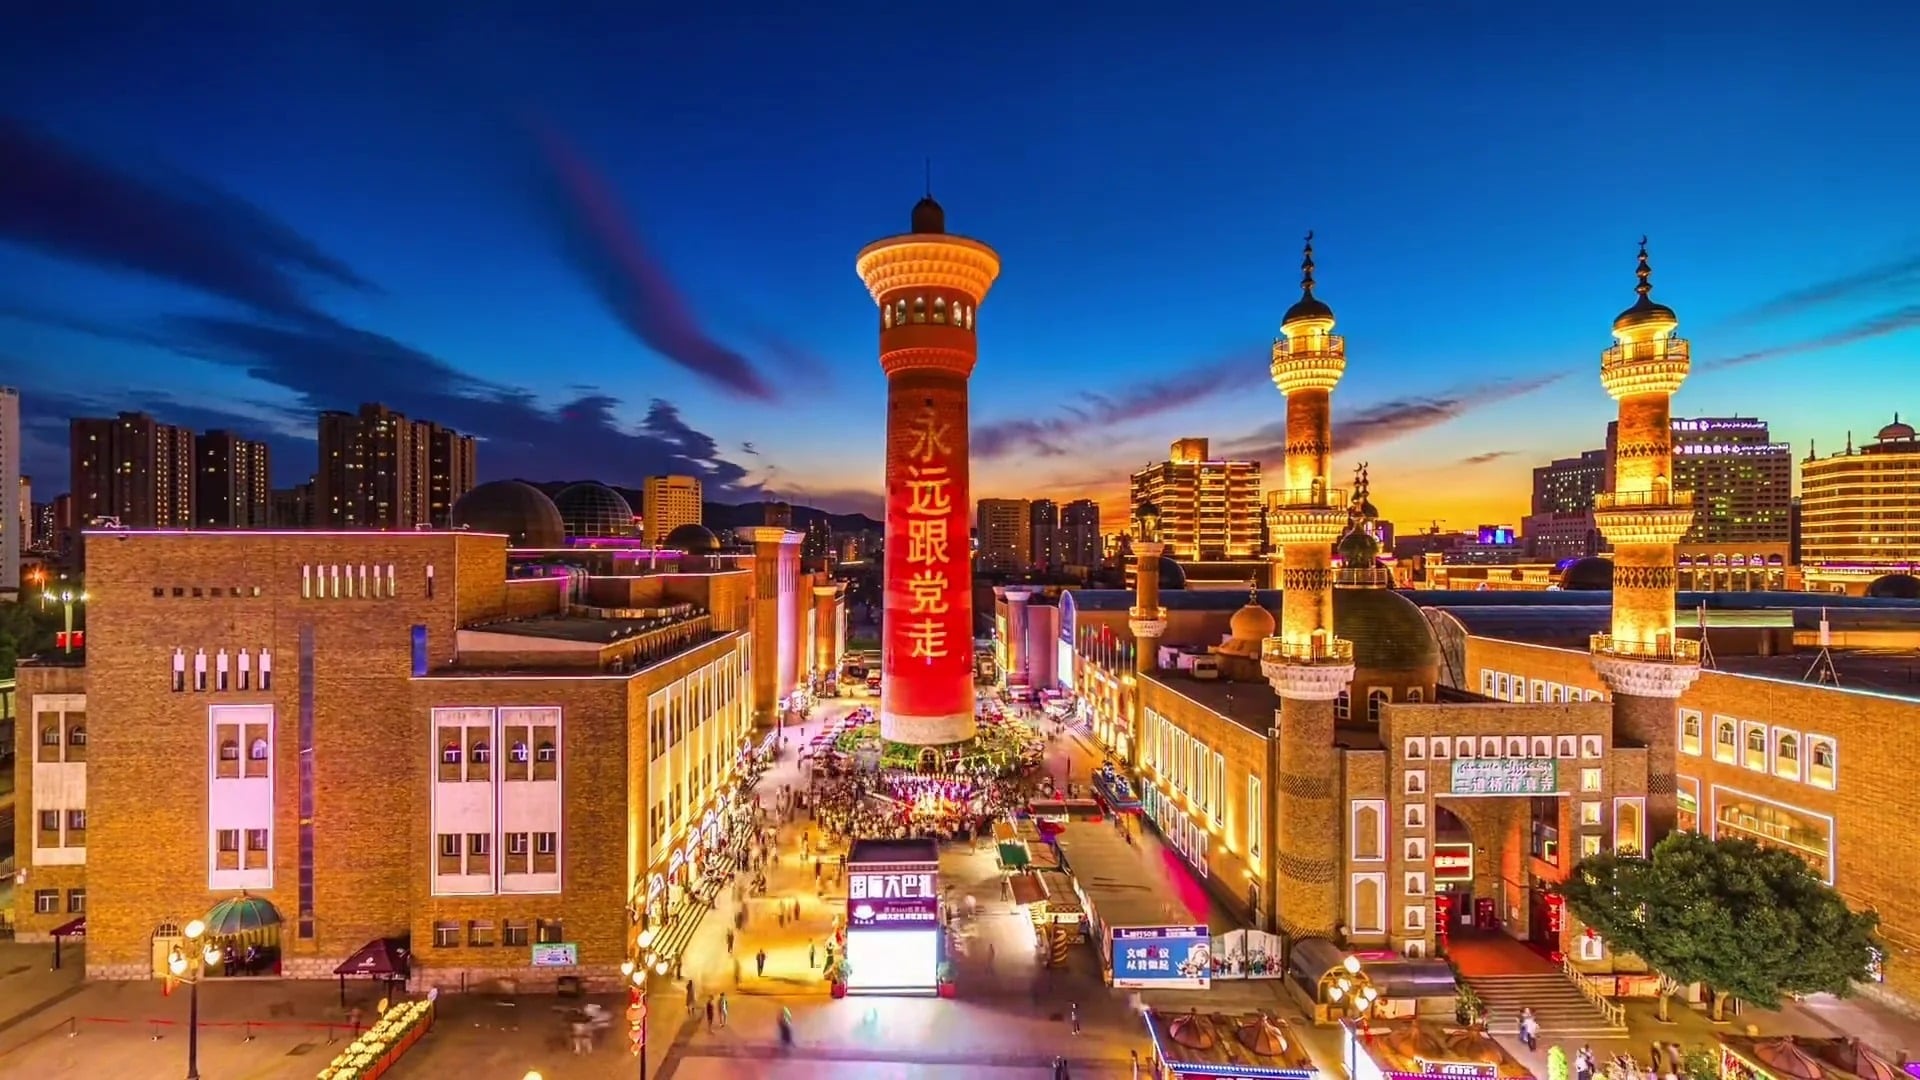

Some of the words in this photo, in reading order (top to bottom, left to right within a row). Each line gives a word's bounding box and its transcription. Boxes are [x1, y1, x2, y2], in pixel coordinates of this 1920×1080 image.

[906, 410, 951, 658] 永远跟党走
[850, 874, 936, 899] 国际大巴扎
